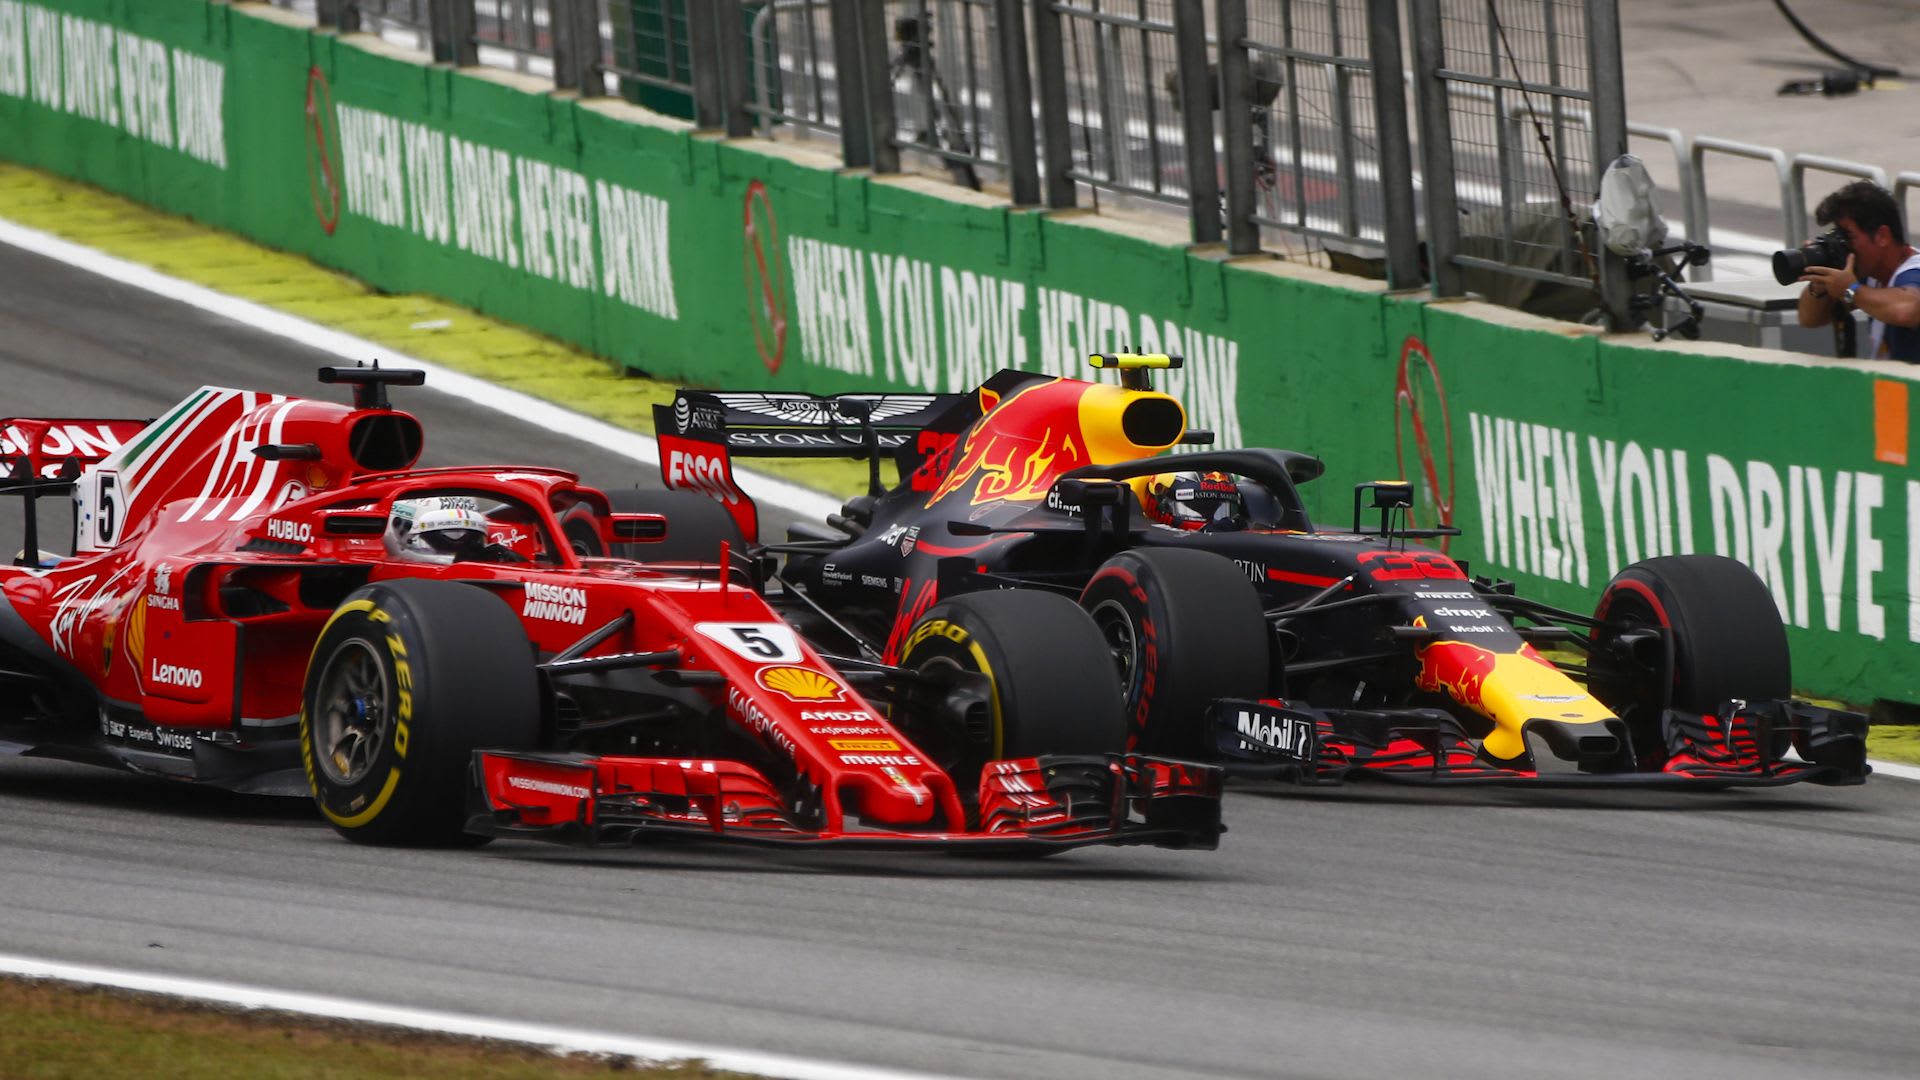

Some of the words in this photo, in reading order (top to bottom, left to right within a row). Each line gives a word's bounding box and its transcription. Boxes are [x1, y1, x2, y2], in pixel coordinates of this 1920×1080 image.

[27, 4, 60, 111] YOU
[336, 103, 405, 230] WHEN
[403, 120, 450, 246] YOU
[450, 135, 519, 269] DRIVE
[516, 156, 597, 293] NEVER
[595, 179, 679, 321] DRINK
[788, 234, 873, 378] WHEN
[870, 251, 938, 394] YOU
[940, 265, 1028, 394] DRIVE
[1139, 313, 1243, 454] DRINK
[781, 402, 820, 411] ASTON
[728, 432, 835, 446] STON
[669, 450, 738, 505] ESSO
[99, 476, 115, 543] 5
[1469, 412, 1590, 588] WHEN
[1588, 434, 1695, 582] YOU
[1706, 453, 1885, 641] DRIVE
[147, 594, 180, 610] SINGHA
[524, 582, 587, 607] MISSION
[1414, 591, 1475, 599] PIRELLI
[522, 599, 587, 625] WINNOW
[1450, 625, 1494, 633] Mobil
[729, 628, 784, 659] 5
[152, 657, 202, 688] Lenovo
[368, 608, 391, 623] P
[386, 632, 413, 760] ZERO
[800, 711, 850, 721] AMD
[156, 726, 192, 750] Swisse
[1237, 711, 1293, 751] Mobil
[839, 755, 921, 765] MAHLE
